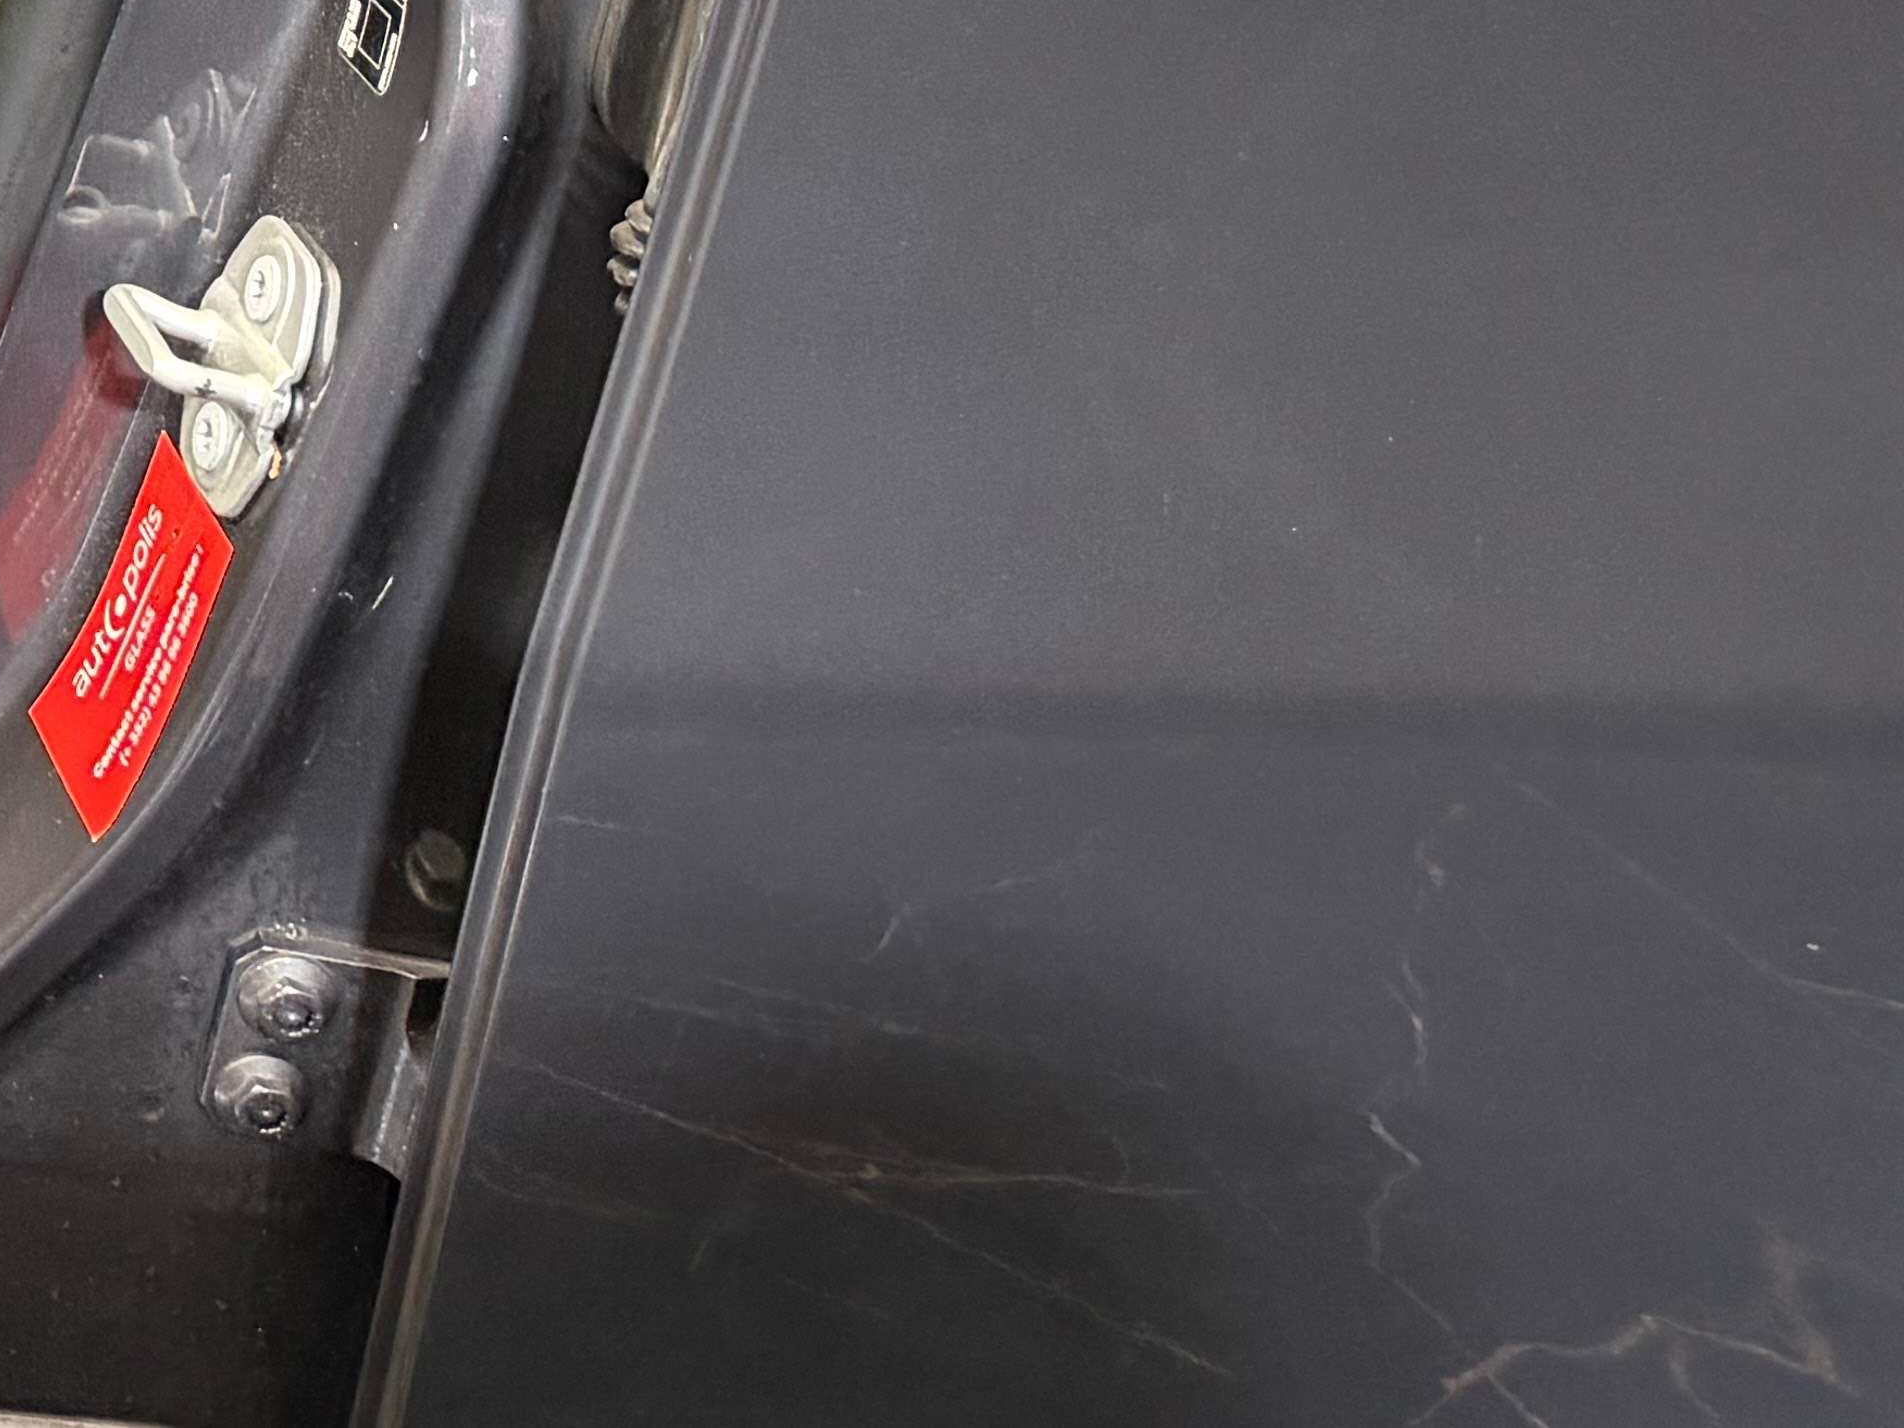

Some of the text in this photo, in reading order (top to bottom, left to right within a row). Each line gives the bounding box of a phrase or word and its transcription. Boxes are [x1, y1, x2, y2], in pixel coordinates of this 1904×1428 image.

[72, 503, 163, 699] autopolis
[124, 603, 156, 672] GLASS
[93, 709, 134, 779] Contact
[130, 647, 162, 712] service
